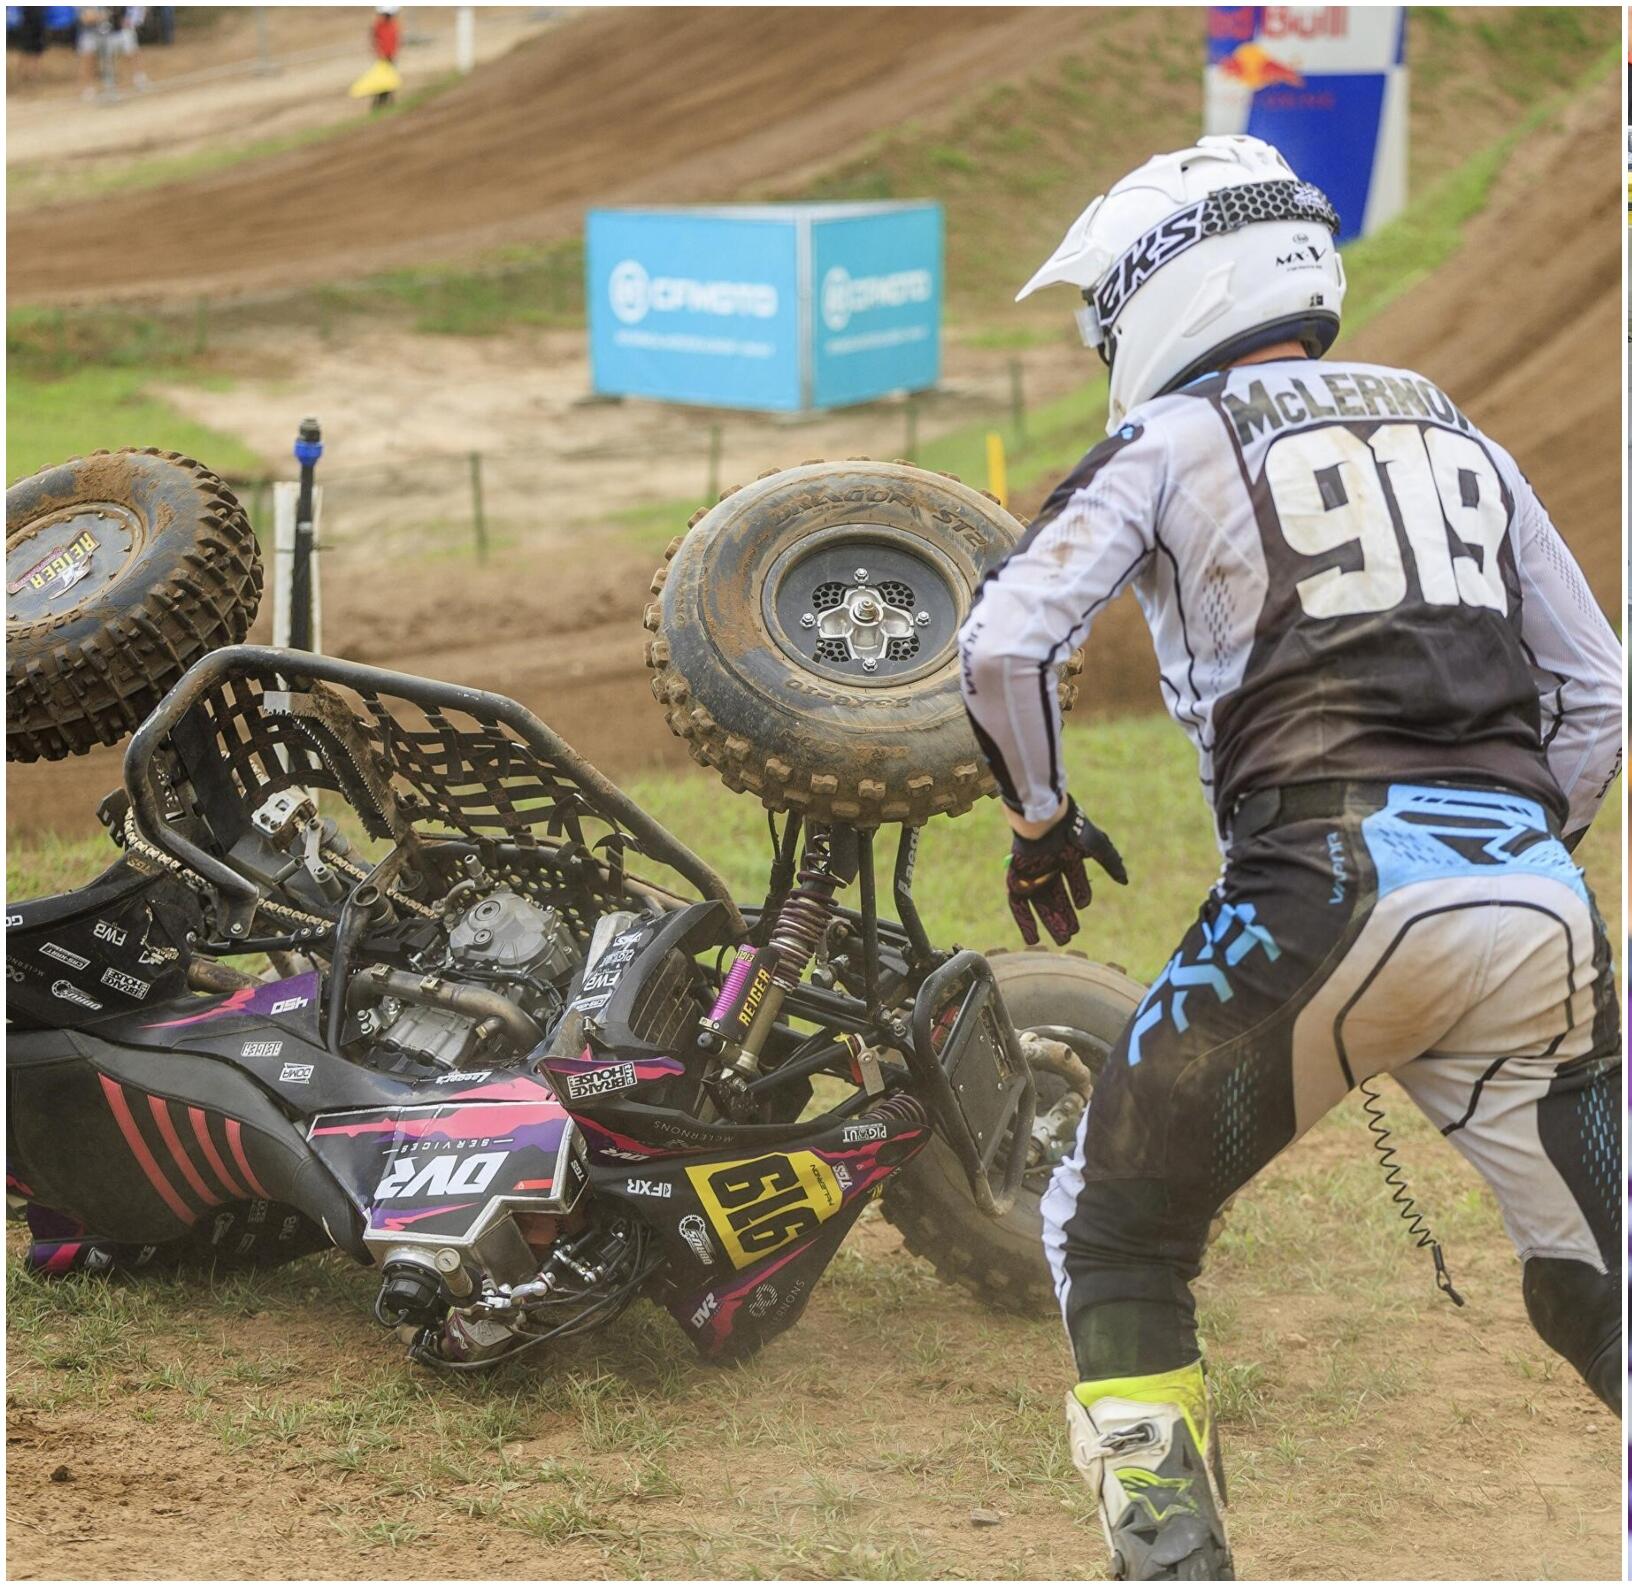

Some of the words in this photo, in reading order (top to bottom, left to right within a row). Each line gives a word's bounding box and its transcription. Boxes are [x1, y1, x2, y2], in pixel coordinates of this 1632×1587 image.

[650, 277, 779, 319] CFMOTO
[851, 268, 932, 312] CFMOTO
[932, 509, 987, 547] ST2
[1265, 424, 1508, 619] 919
[30, 531, 95, 590] REIGER
[93, 922, 127, 947] FWB
[738, 967, 771, 1027] REIGER
[571, 1076, 625, 1099] BRAKE
[573, 1062, 625, 1086] HOUSE
[401, 1138, 490, 1154] SERVICES
[374, 1151, 511, 1200] DVR
[570, 1160, 584, 1182] TGS
[627, 1178, 664, 1197] FXR
[690, 1292, 719, 1329] DVR
